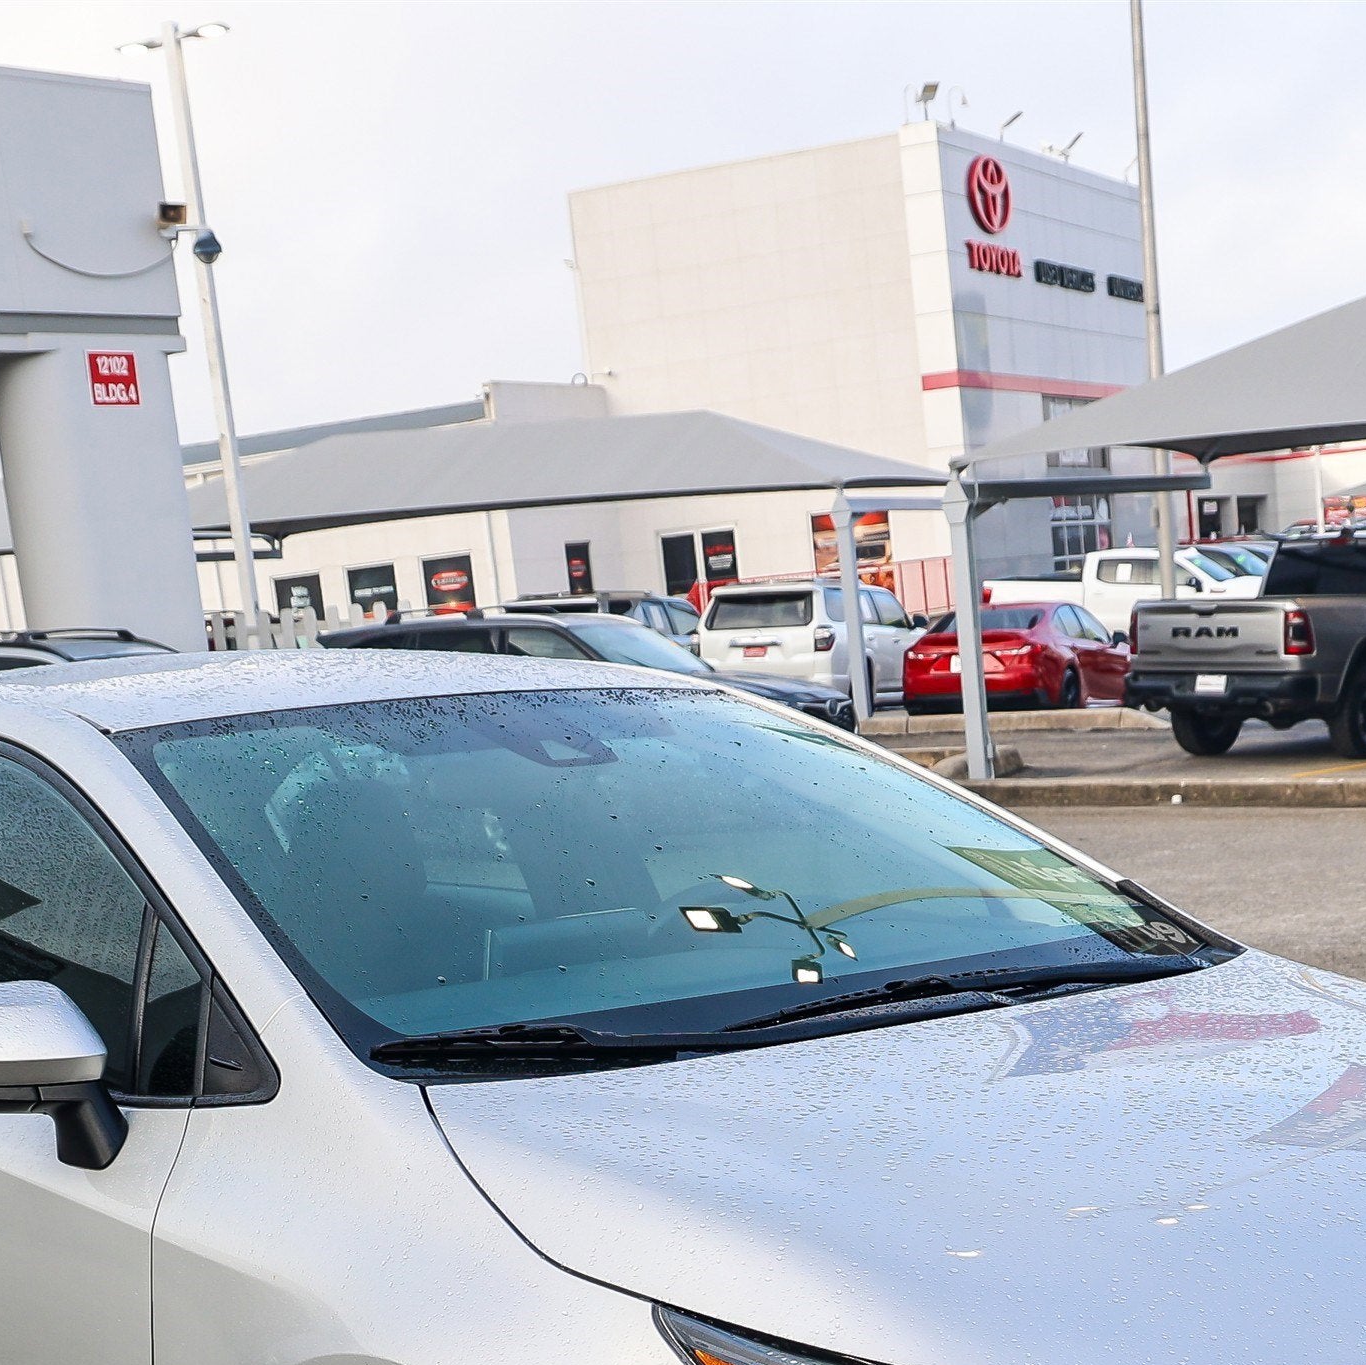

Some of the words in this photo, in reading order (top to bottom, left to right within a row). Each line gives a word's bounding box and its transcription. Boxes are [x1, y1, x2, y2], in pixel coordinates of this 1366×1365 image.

[966, 239, 1022, 278] TOYOTA
[96, 355, 129, 376] 12102
[94, 383, 129, 403] BLDG
[1171, 626, 1239, 639] RAM
